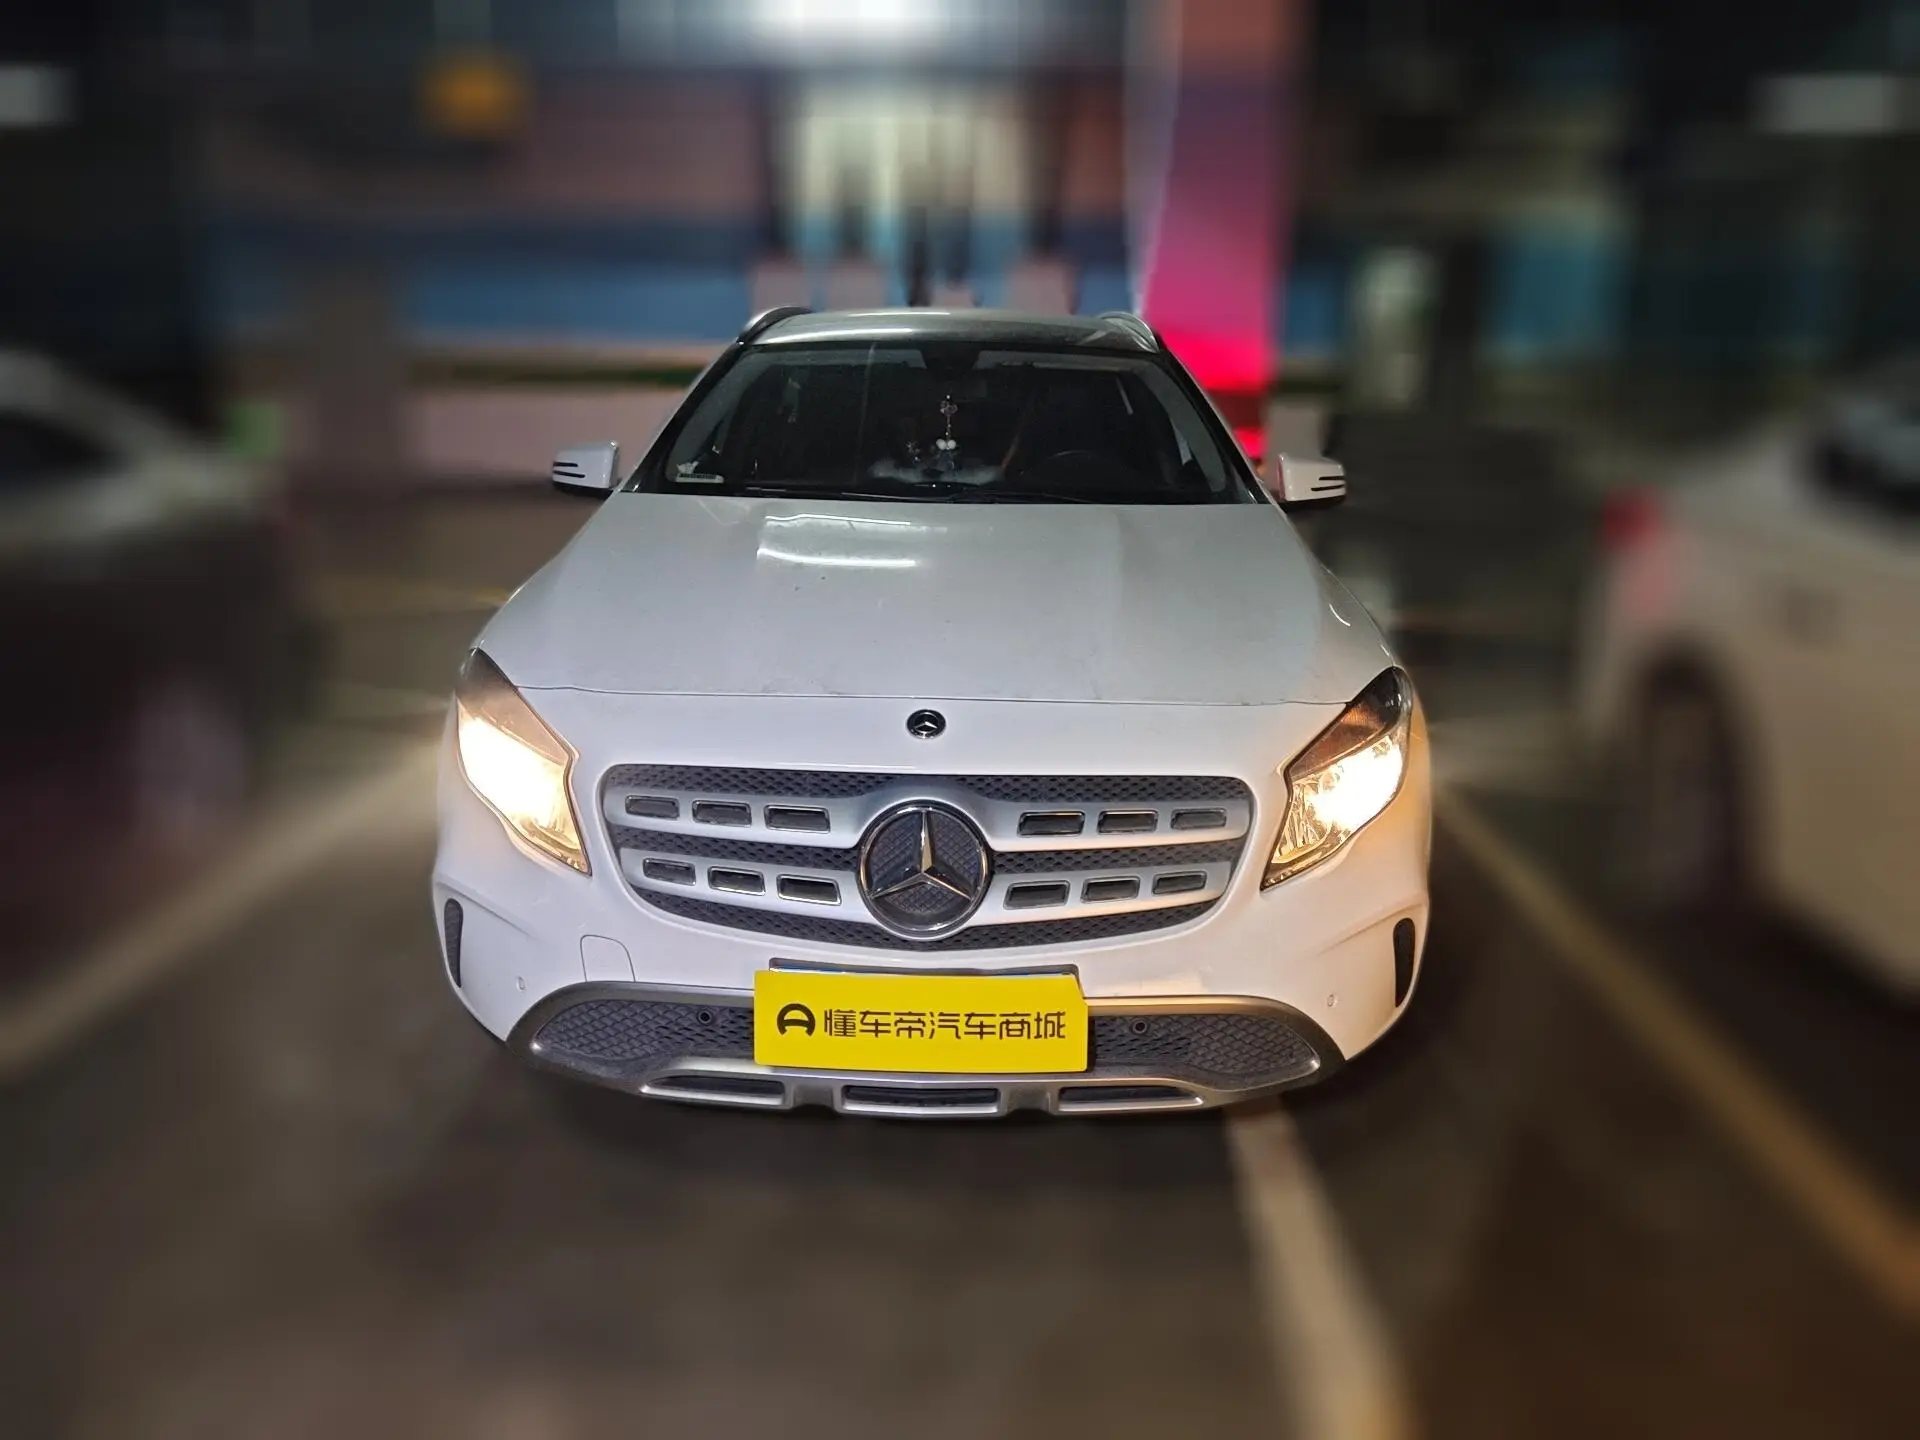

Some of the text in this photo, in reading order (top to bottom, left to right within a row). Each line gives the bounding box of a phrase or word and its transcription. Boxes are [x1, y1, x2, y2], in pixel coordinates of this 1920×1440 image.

[824, 1009, 1066, 1040] 懂车帝汽车商城
